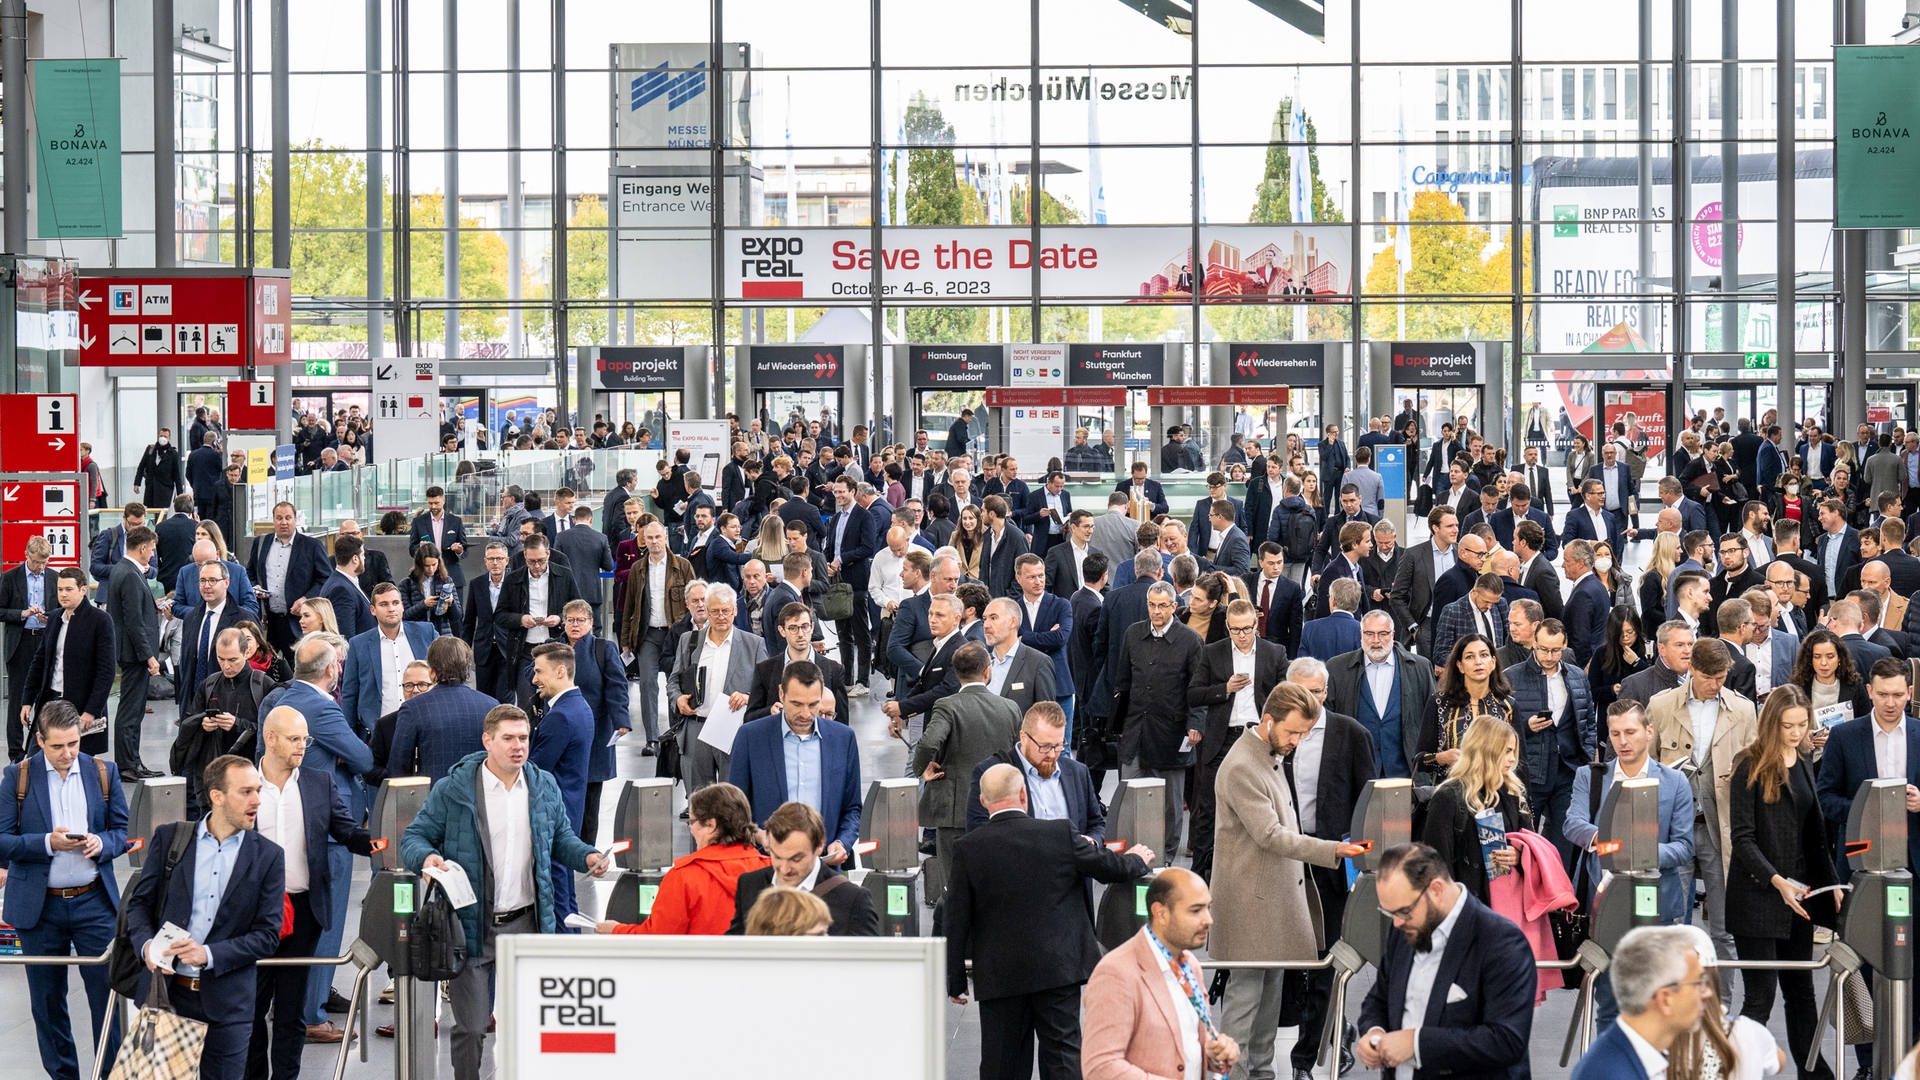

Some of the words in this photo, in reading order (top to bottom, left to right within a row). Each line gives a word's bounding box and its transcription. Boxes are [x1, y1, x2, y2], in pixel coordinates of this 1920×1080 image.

[668, 126, 706, 134] MESSE
[1852, 129, 1910, 138] BONAVA
[51, 140, 107, 150] BONAVA
[623, 183, 681, 196] Eingang
[623, 201, 685, 212] Entrance
[1584, 208, 1609, 219] BNP
[742, 238, 803, 260] expo
[832, 240, 920, 270] Save
[934, 240, 992, 270] the
[1009, 240, 1097, 269] Date
[742, 258, 803, 277] real
[946, 281, 990, 294] 2023
[1554, 270, 1608, 300] READY
[1587, 305, 1617, 327] REAL
[928, 352, 967, 361] Hamburg
[1102, 350, 1142, 358] Frankfurt
[608, 358, 677, 373] apoprojekt
[757, 362, 770, 370] Auf
[771, 362, 827, 370] Wiedersehen
[828, 362, 836, 370] in
[967, 362, 991, 370] Berlin
[1085, 361, 1125, 370] Stuttgart
[1310, 358, 1316, 367] in
[1406, 354, 1472, 368] apoprojekt
[937, 373, 983, 381] Düsseldorf
[1112, 371, 1152, 380] München
[540, 978, 616, 1007] expo
[540, 1005, 616, 1026] real
